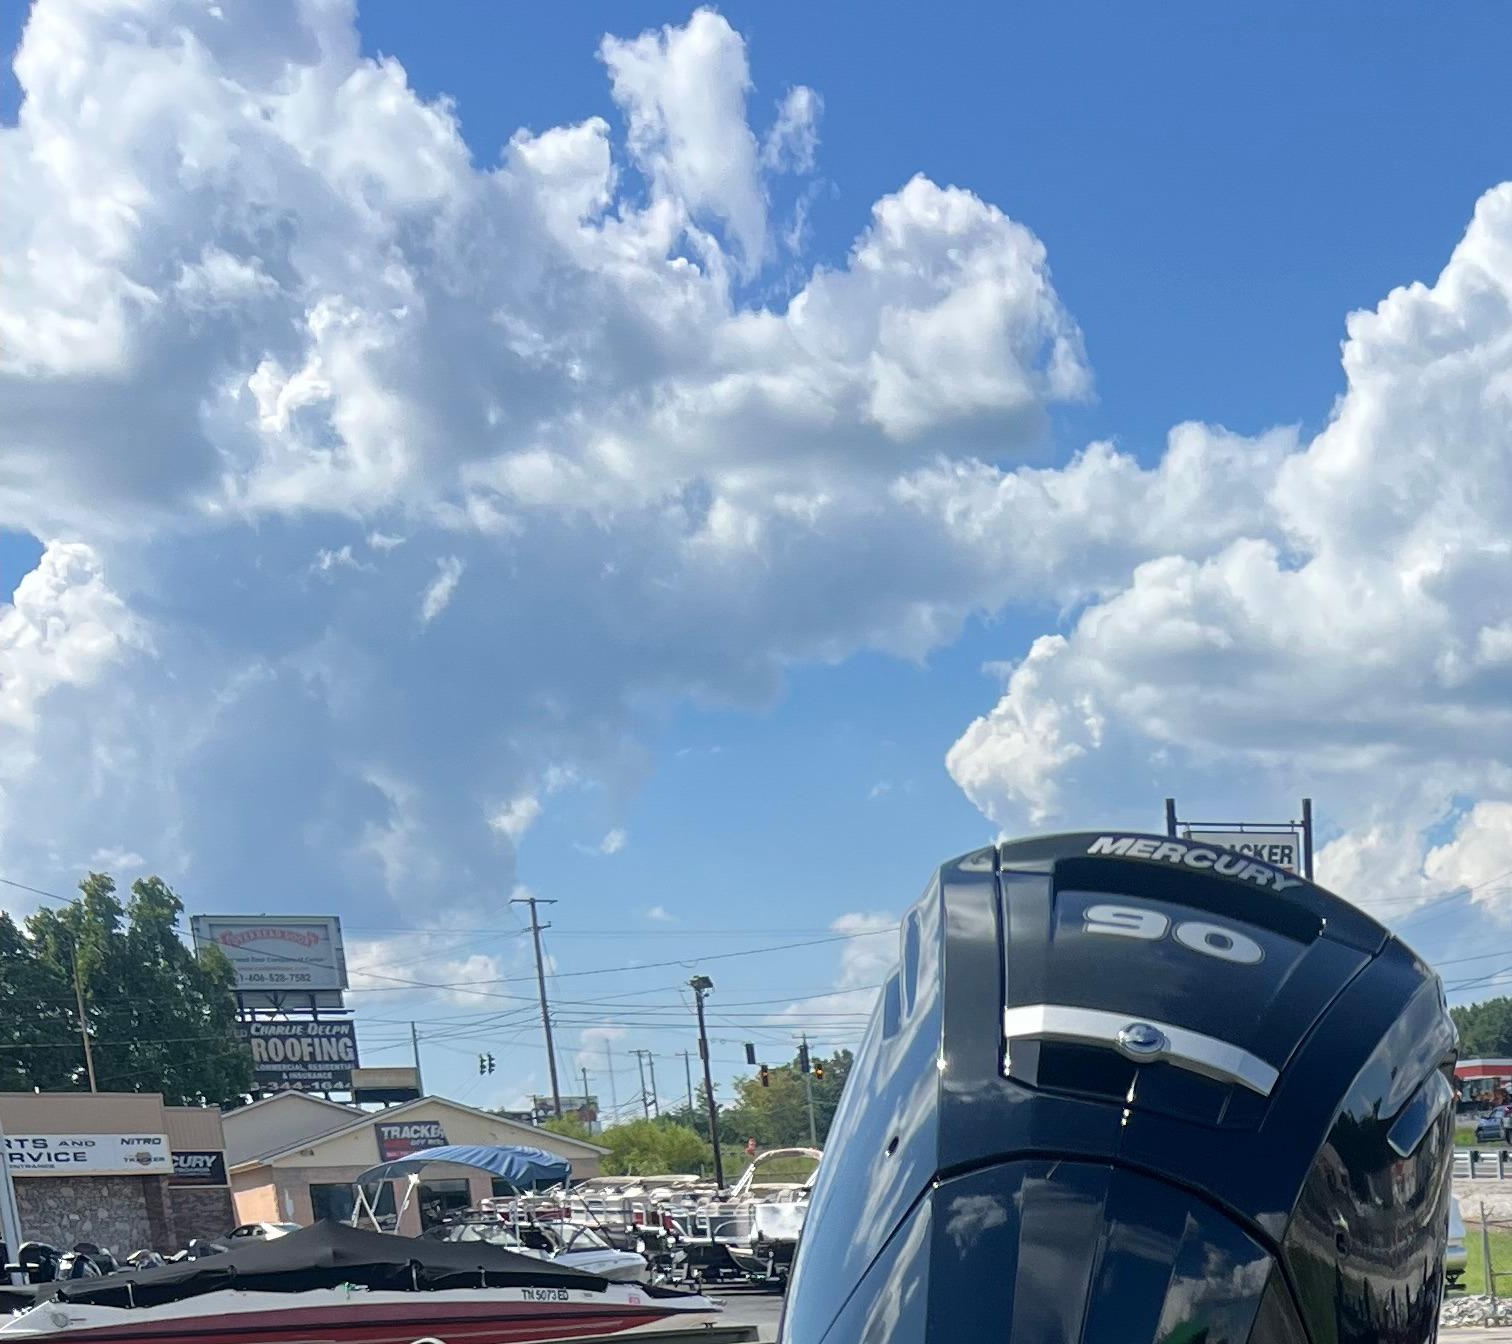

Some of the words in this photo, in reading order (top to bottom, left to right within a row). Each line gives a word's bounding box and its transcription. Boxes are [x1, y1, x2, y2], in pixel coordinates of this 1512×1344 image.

[1087, 836, 1303, 892] MERCURY
[1082, 903, 1265, 966] 90
[250, 1022, 303, 1036] CHARLIE
[251, 1037, 355, 1062] ROOFING
[58, 1140, 96, 1148] AND
[120, 1137, 162, 1146] NITRO
[521, 1288, 535, 1301] TN
[536, 1288, 557, 1302] 5073
